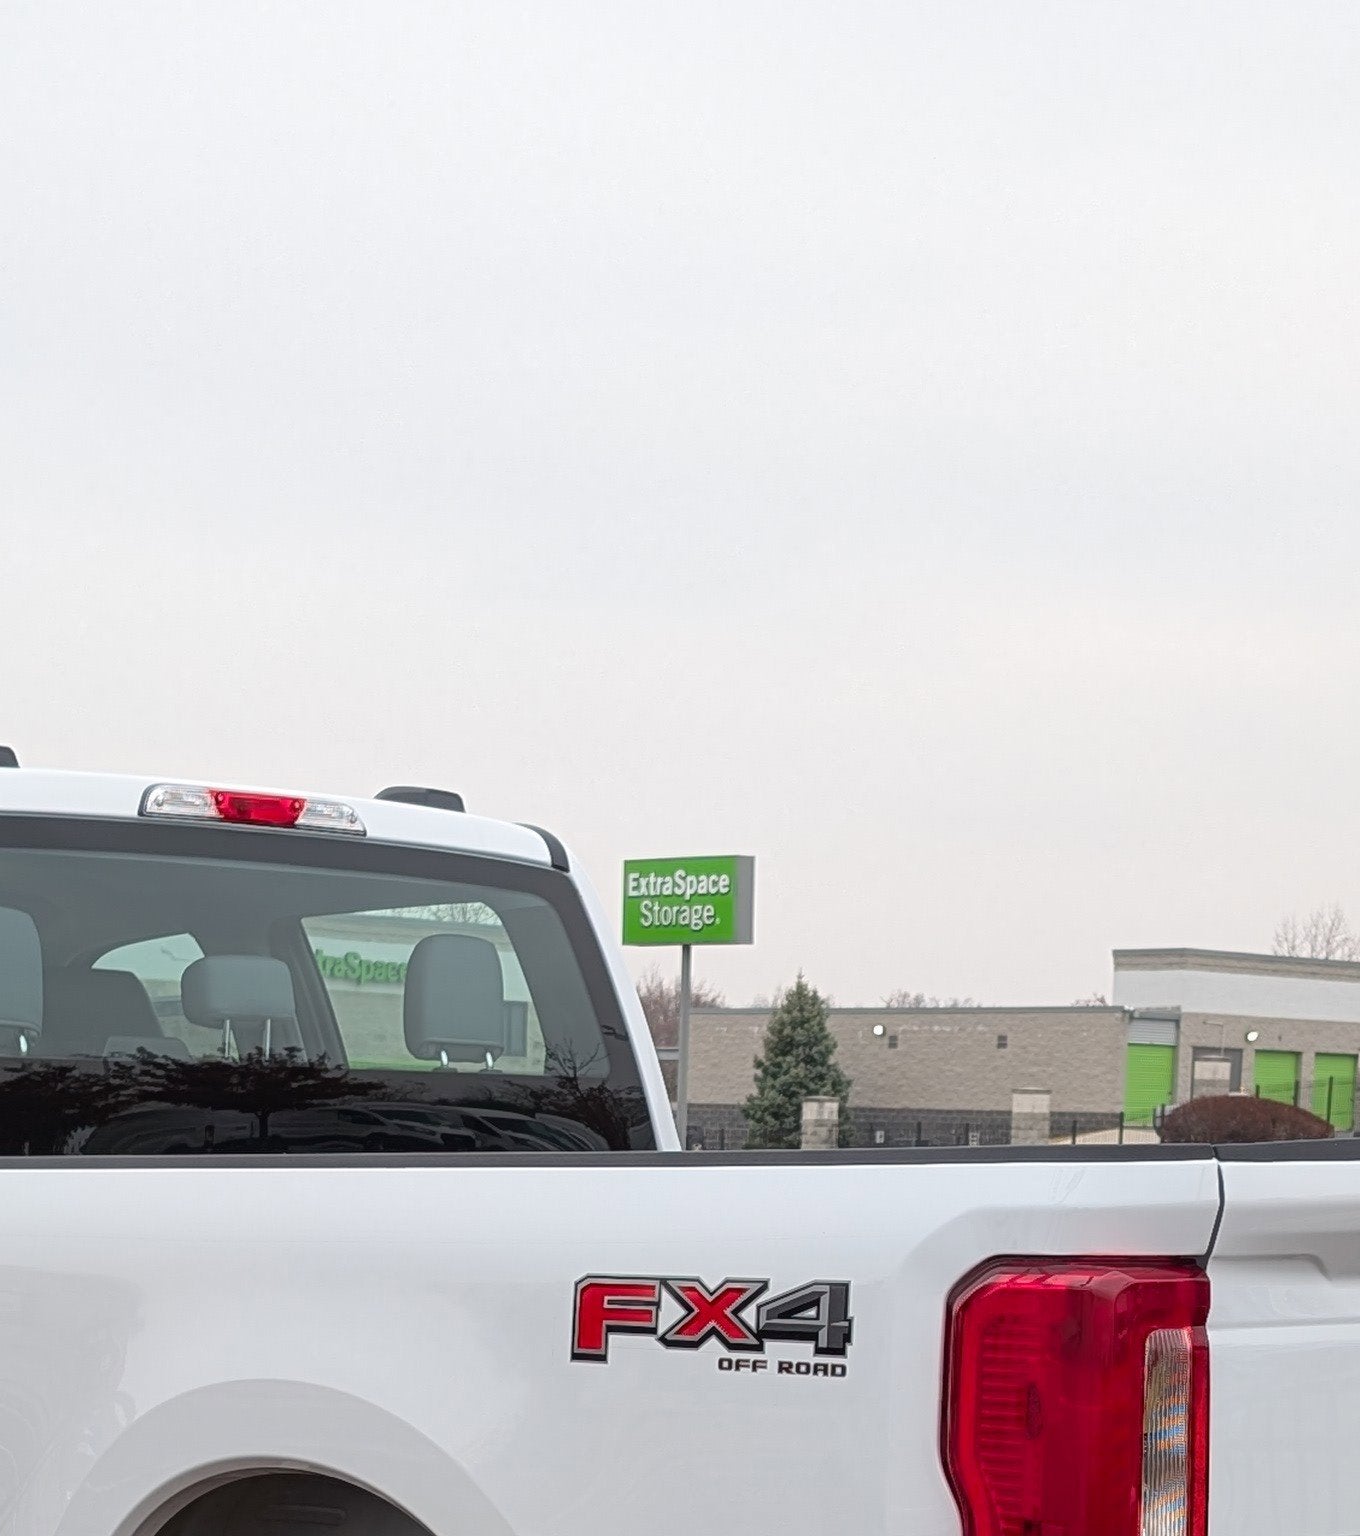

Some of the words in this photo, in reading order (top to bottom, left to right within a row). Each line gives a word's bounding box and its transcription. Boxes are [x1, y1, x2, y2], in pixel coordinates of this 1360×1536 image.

[628, 869, 730, 900] ExtraSpace
[570, 1273, 854, 1364] FX4
[718, 1357, 768, 1373] OFF
[777, 1359, 847, 1377] ROAD
